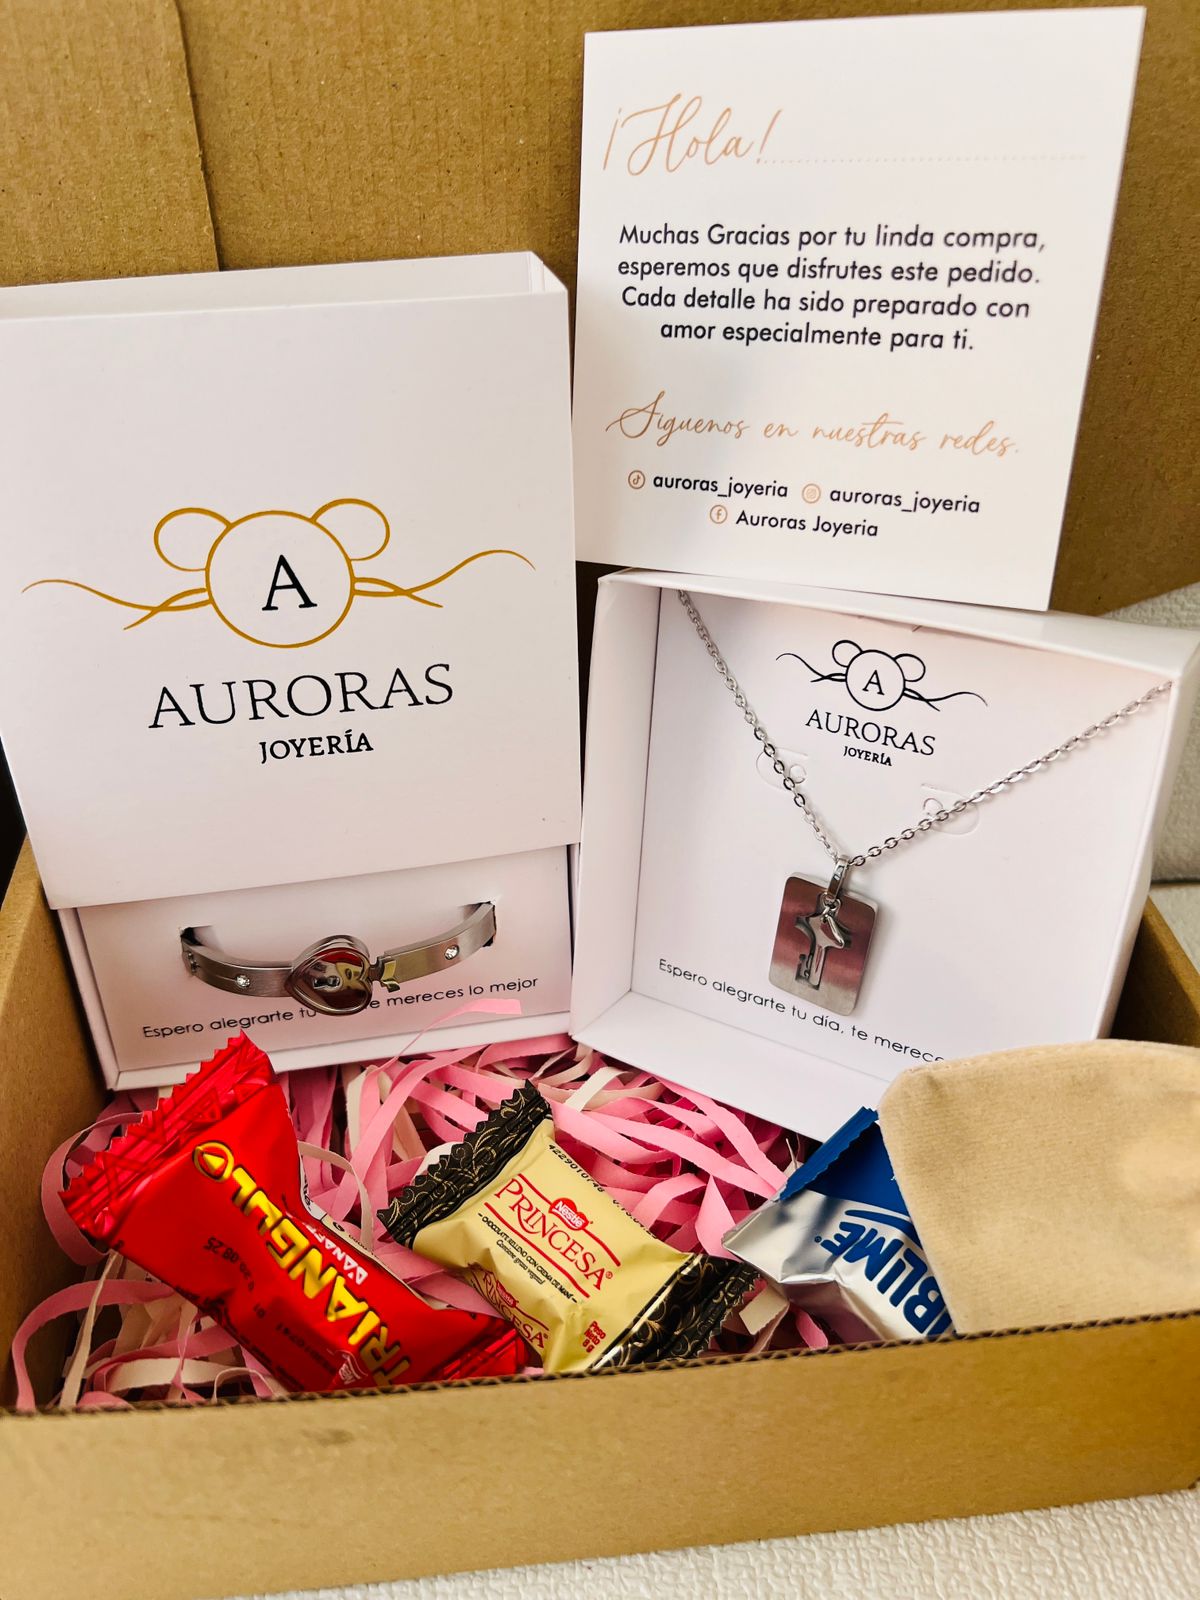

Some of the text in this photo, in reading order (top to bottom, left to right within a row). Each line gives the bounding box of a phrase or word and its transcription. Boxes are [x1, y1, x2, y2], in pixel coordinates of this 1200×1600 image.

[602, 93, 783, 176] ¡Hola!
[619, 223, 1046, 254] Muchas Gracias por tu linda compra,
[617, 256, 1041, 289] esperemos que disfrutes este pedido.
[621, 285, 1030, 321] Cada detalle ha sido preparado con
[660, 320, 975, 353] amor especialmente para ti.
[763, 421, 799, 439] en
[812, 412, 926, 450] nuestras
[652, 475, 981, 515] auroras_joyeria auroras_joyeria
[735, 509, 880, 539] Auroras Joyeria
[261, 554, 318, 612] A
[148, 663, 454, 729] AURORAS
[862, 669, 886, 697] A
[259, 729, 375, 765] JOYERÍA
[805, 709, 936, 756] AURORAS
[843, 746, 893, 767] JOYERÍA
[142, 1021, 204, 1040] Espero
[209, 1008, 294, 1033] alegrarte
[299, 1007, 317, 1019] tu
[387, 988, 464, 1007] mereces
[469, 984, 485, 997] lo
[490, 975, 538, 995] mejor
[658, 958, 708, 987] Espero
[712, 978, 787, 1014] alegrarte
[791, 1005, 807, 1020] tu
[812, 1012, 844, 1034] día,
[851, 1024, 868, 1041] te
[494, 1178, 606, 1291] PRINCESA
